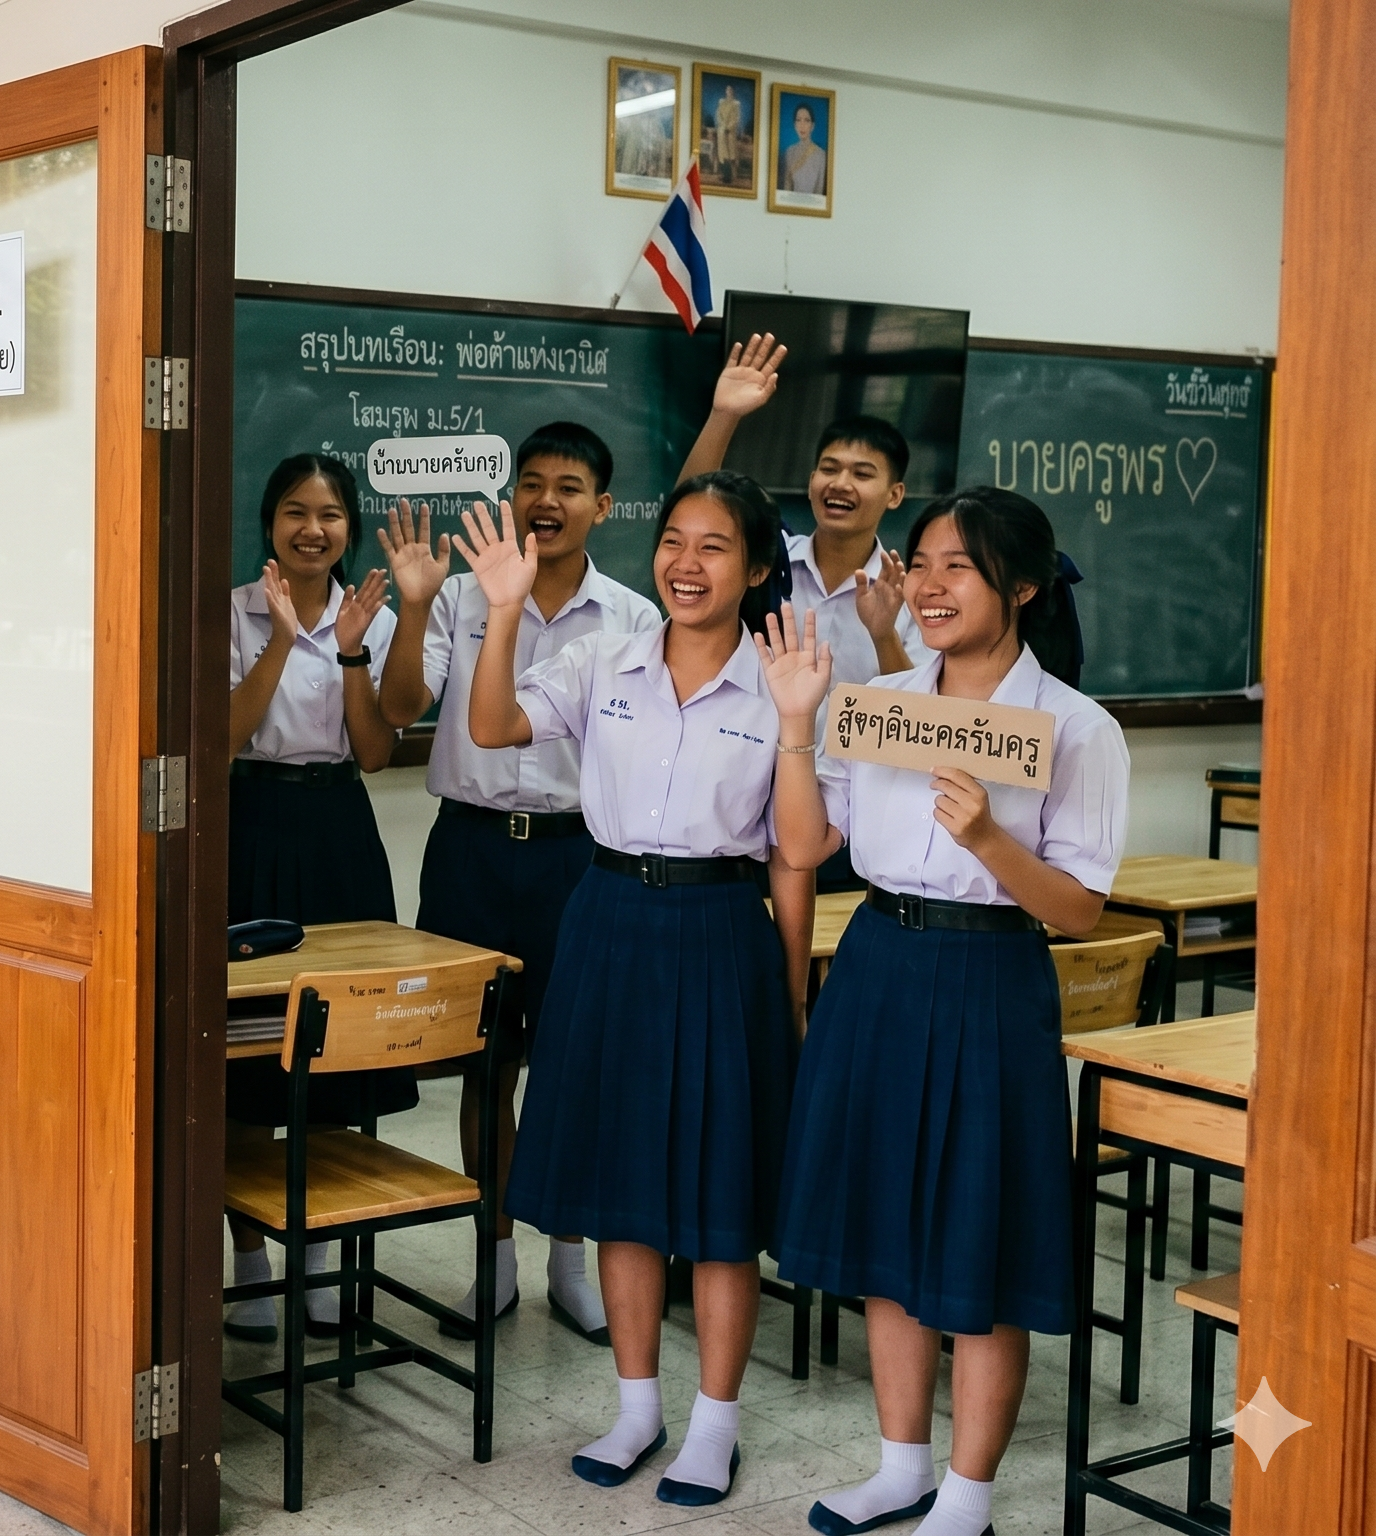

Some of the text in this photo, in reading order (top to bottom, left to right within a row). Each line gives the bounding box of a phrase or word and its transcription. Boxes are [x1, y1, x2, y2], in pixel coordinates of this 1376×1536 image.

[427, 405, 486, 433] ม.5/1
[988, 439, 1167, 524] บายครูพร
